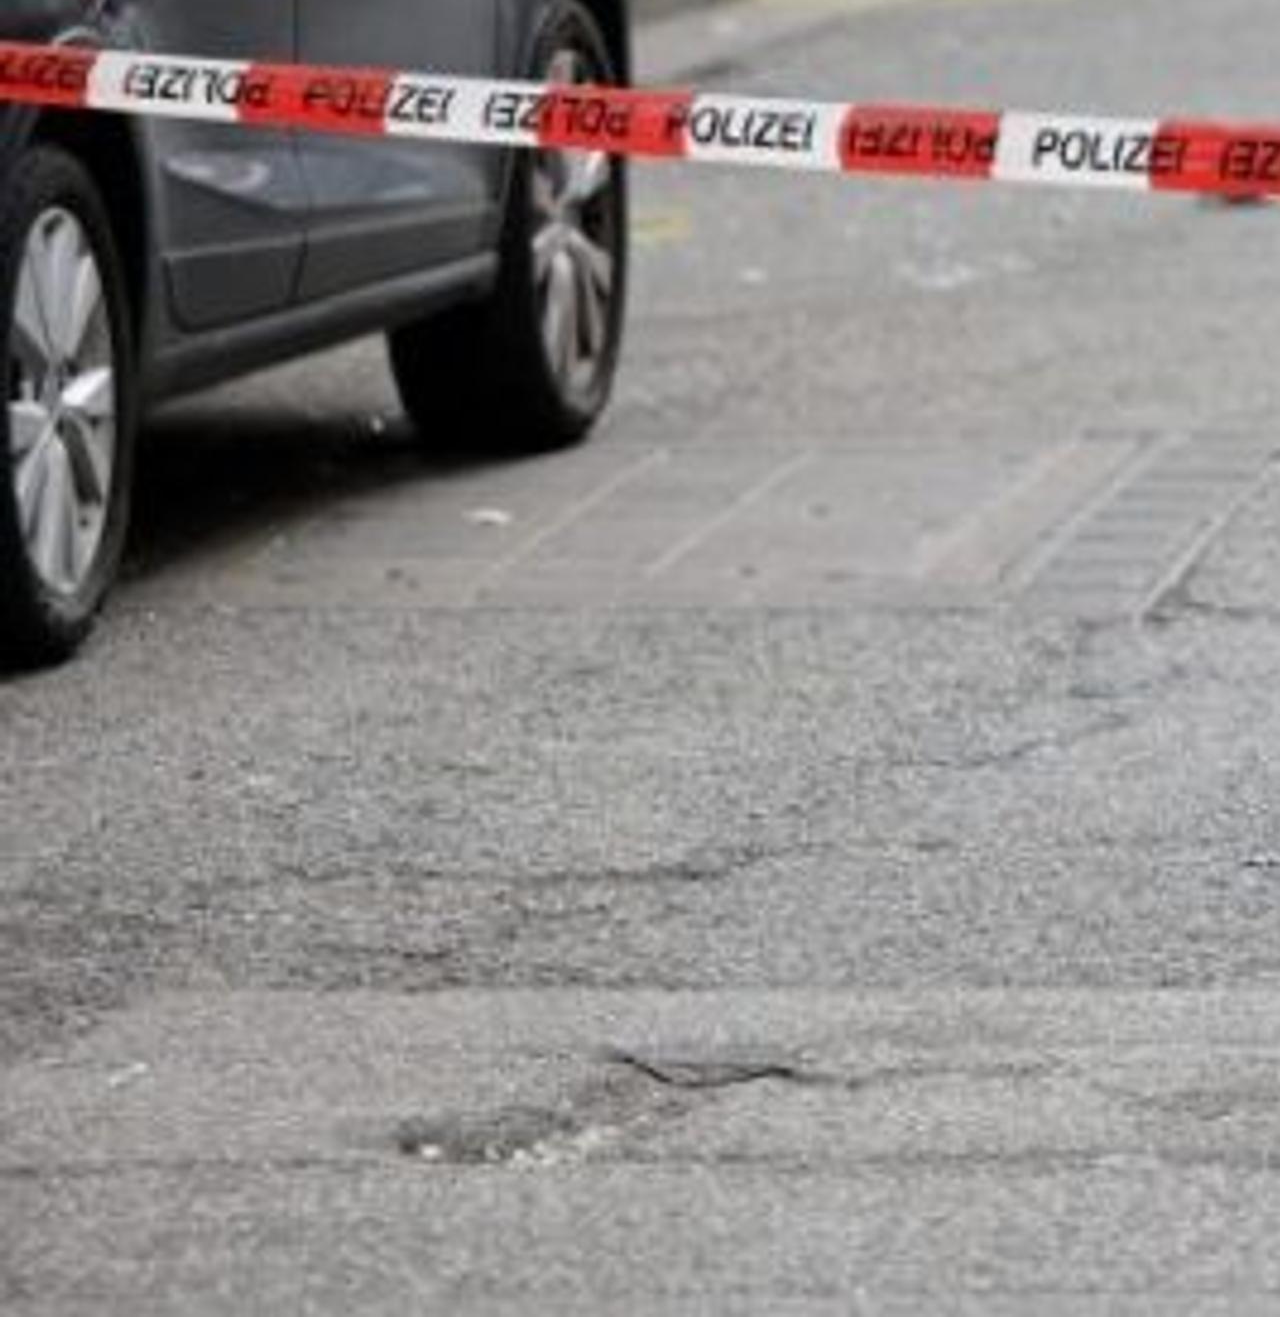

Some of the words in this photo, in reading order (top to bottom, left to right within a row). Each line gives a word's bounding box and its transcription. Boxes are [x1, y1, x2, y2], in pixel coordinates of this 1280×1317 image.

[0, 51, 94, 90] LIZEI
[123, 62, 274, 108] POLIZEI
[302, 80, 453, 124] POLIZEI
[484, 91, 632, 138] POLIZEI
[664, 102, 817, 150] POLIZEI
[1032, 128, 1190, 175] POLIZEI
